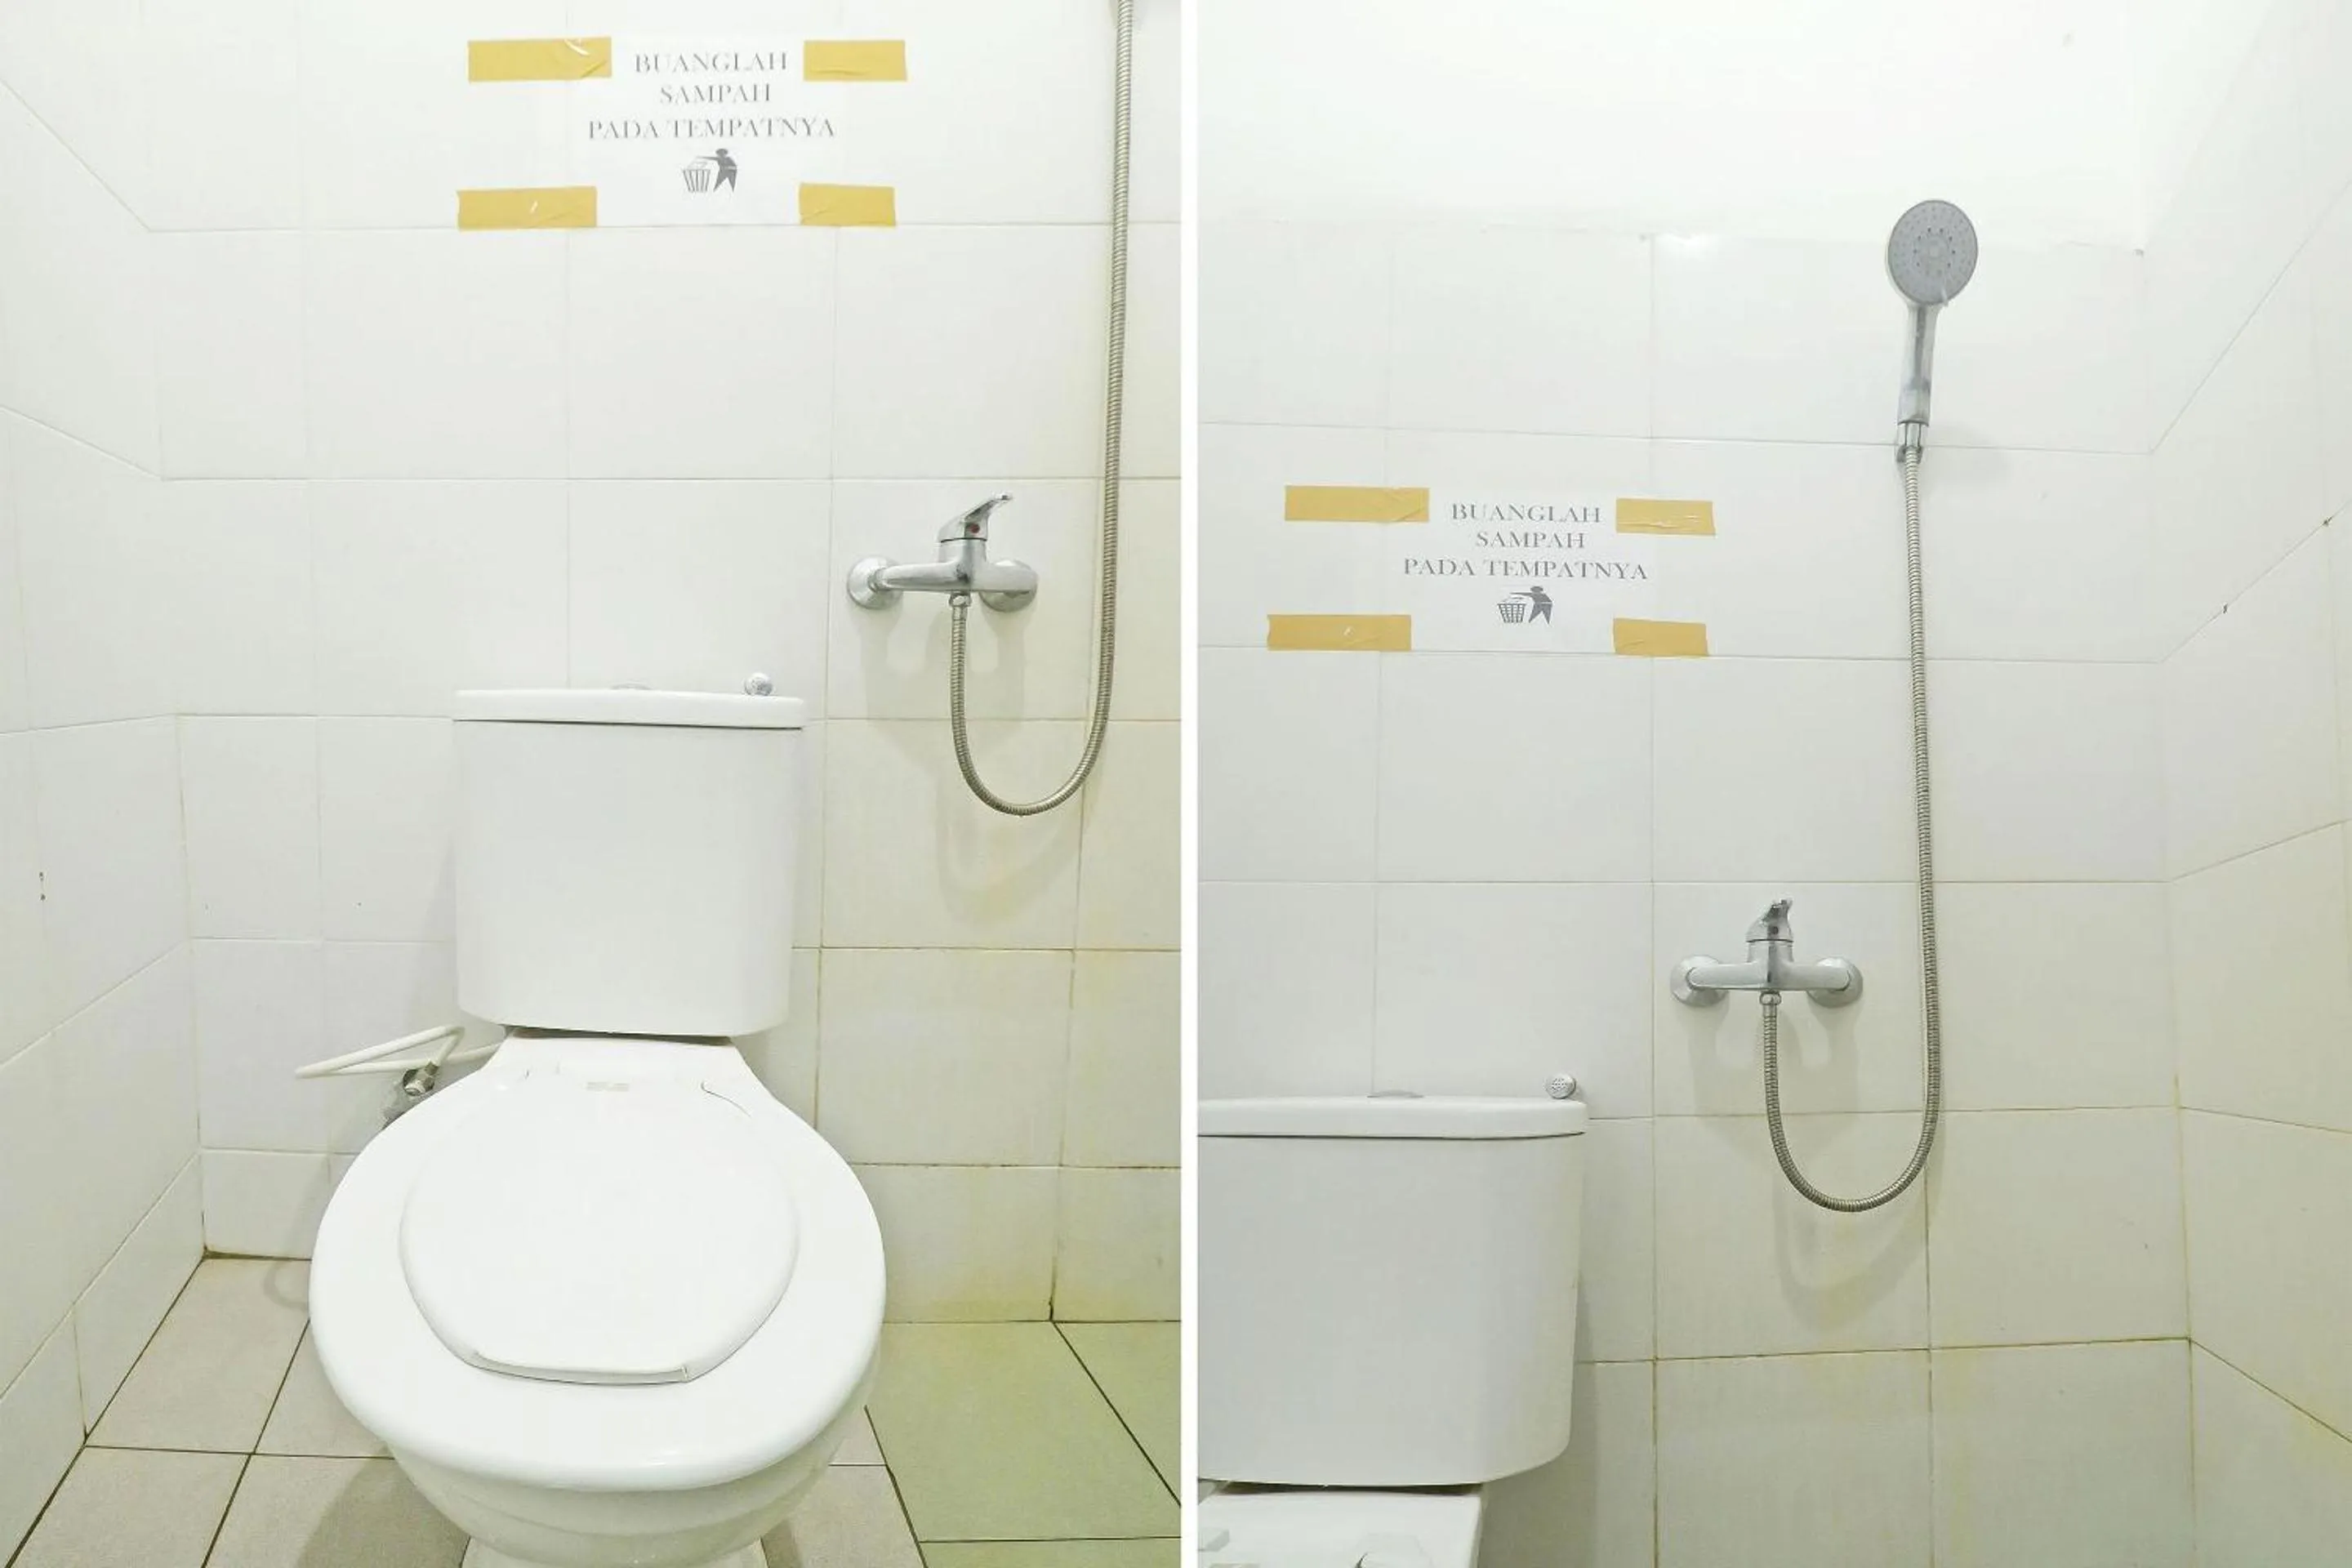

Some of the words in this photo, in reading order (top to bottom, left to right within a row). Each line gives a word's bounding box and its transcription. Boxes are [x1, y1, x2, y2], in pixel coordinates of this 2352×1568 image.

[635, 51, 787, 74] BUANGLAH
[660, 82, 771, 104] SAMPAH
[588, 119, 660, 140] PADA
[666, 117, 835, 138] TEMPATNYA
[1451, 502, 1601, 523] BUANGLAH
[1475, 530, 1585, 549] SAMPAH
[1403, 557, 1476, 577] PADA
[1482, 559, 1649, 581] TEMPATNYA
